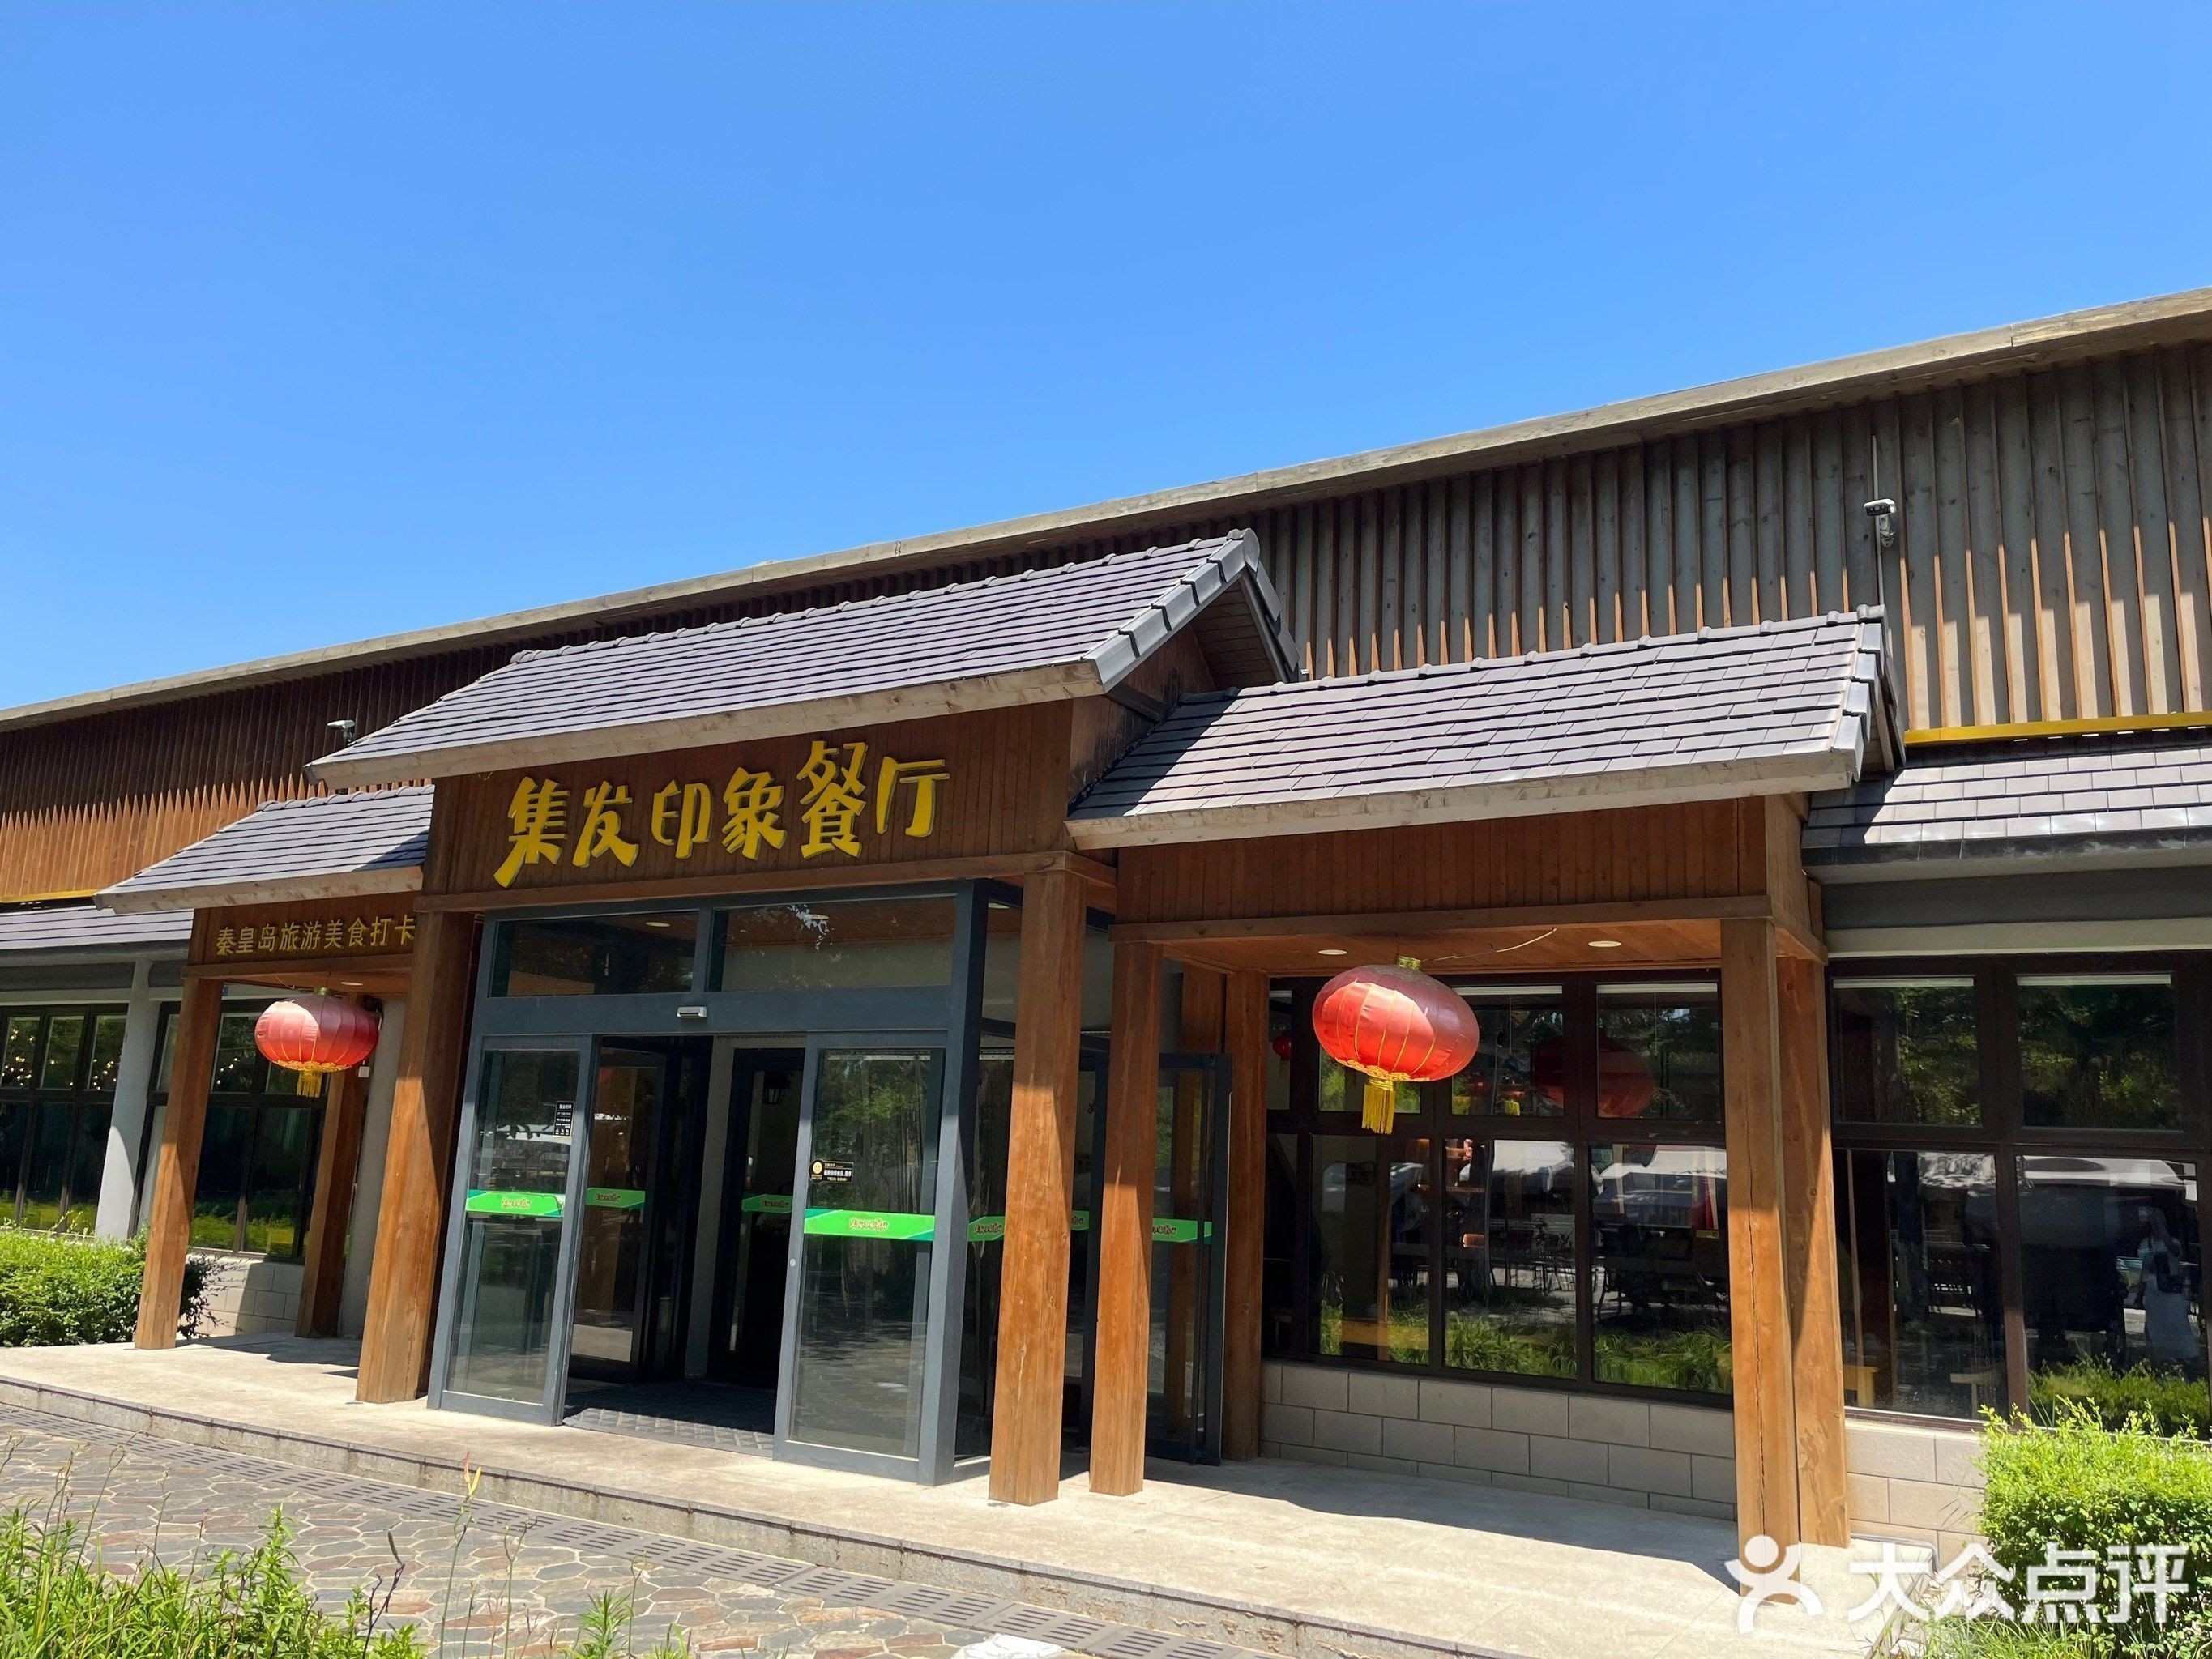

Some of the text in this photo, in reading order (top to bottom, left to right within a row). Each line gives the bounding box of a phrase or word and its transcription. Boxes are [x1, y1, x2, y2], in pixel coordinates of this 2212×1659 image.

[493, 740, 950, 889] 集发印象餐厅
[216, 915, 415, 956] 秦皇岛旅游美食打卡
